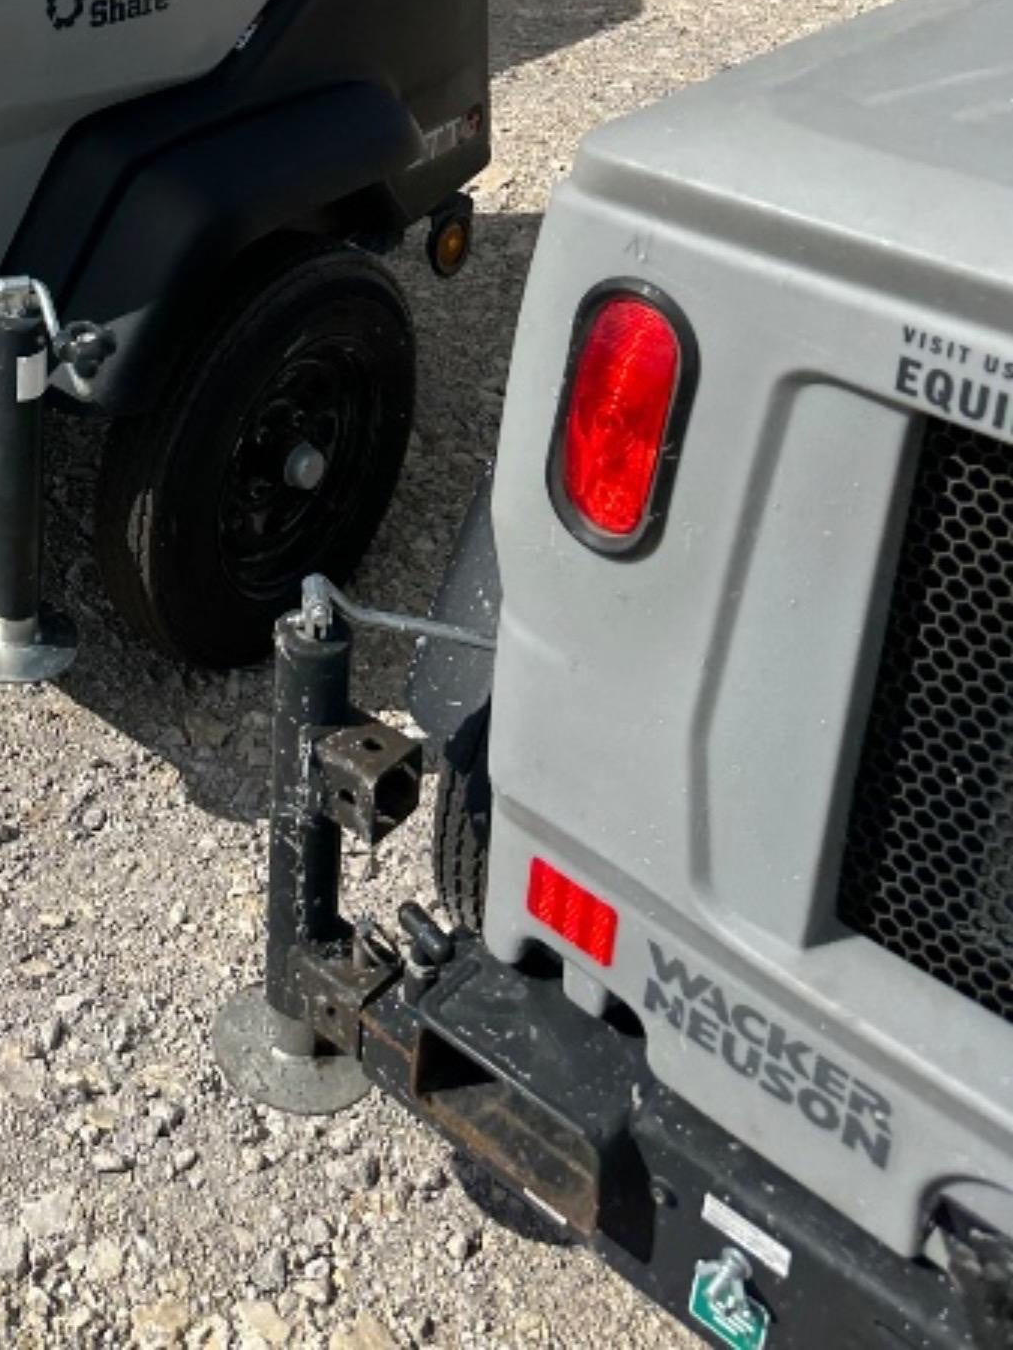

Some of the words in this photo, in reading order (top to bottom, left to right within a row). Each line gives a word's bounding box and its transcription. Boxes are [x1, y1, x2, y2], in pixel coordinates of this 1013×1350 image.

[895, 356, 1013, 434] EQUI
[903, 326, 971, 364] VISIT
[984, 354, 1013, 379] US
[644, 977, 891, 1170] NEUSON
[647, 938, 891, 1136] WACKER
